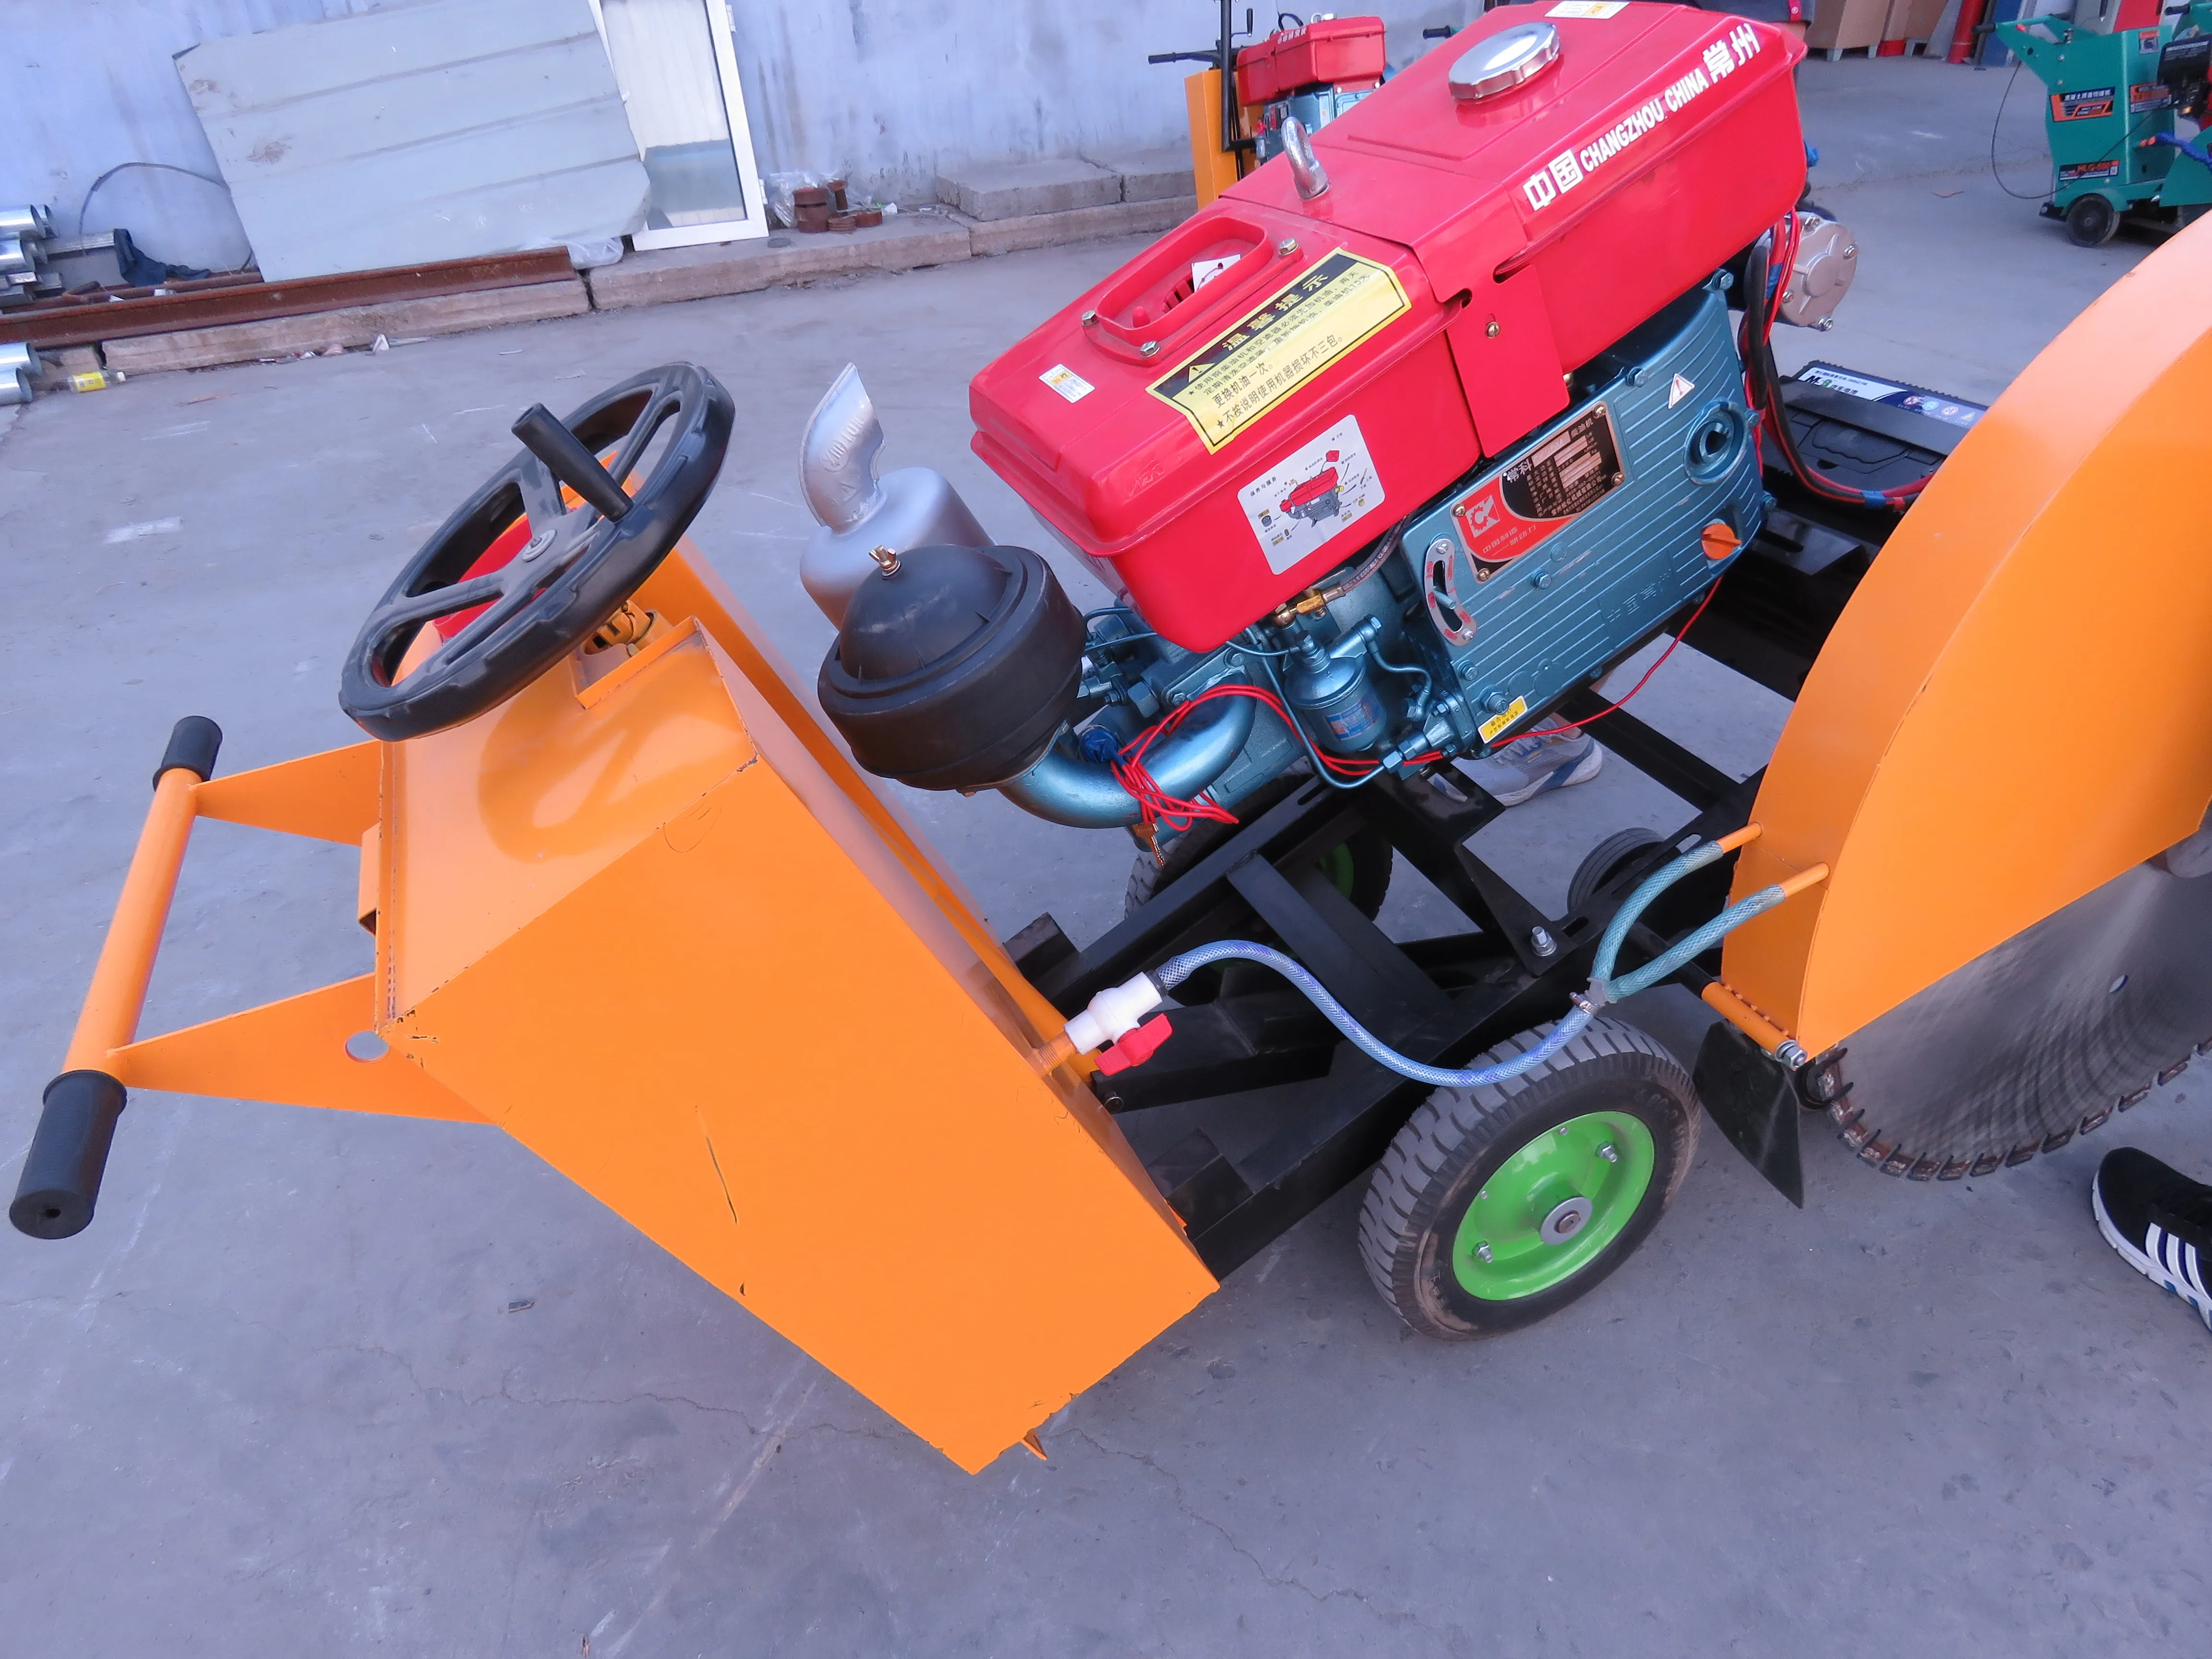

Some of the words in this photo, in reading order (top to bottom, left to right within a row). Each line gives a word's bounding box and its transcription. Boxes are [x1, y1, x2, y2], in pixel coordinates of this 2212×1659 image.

[1523, 149, 1583, 211] 中国
[1580, 101, 1665, 172] CHANGZHOU
[1664, 68, 1708, 112] CHINA
[1702, 22, 1761, 84] 常州
[1221, 274, 1330, 351] 温馨提示
[1223, 334, 1344, 423] 不按说明使用机器损坏不三包。
[1507, 459, 1533, 484] 常科
[1570, 418, 1594, 437] 柴油机
[1483, 526, 1518, 554] 中国制造
